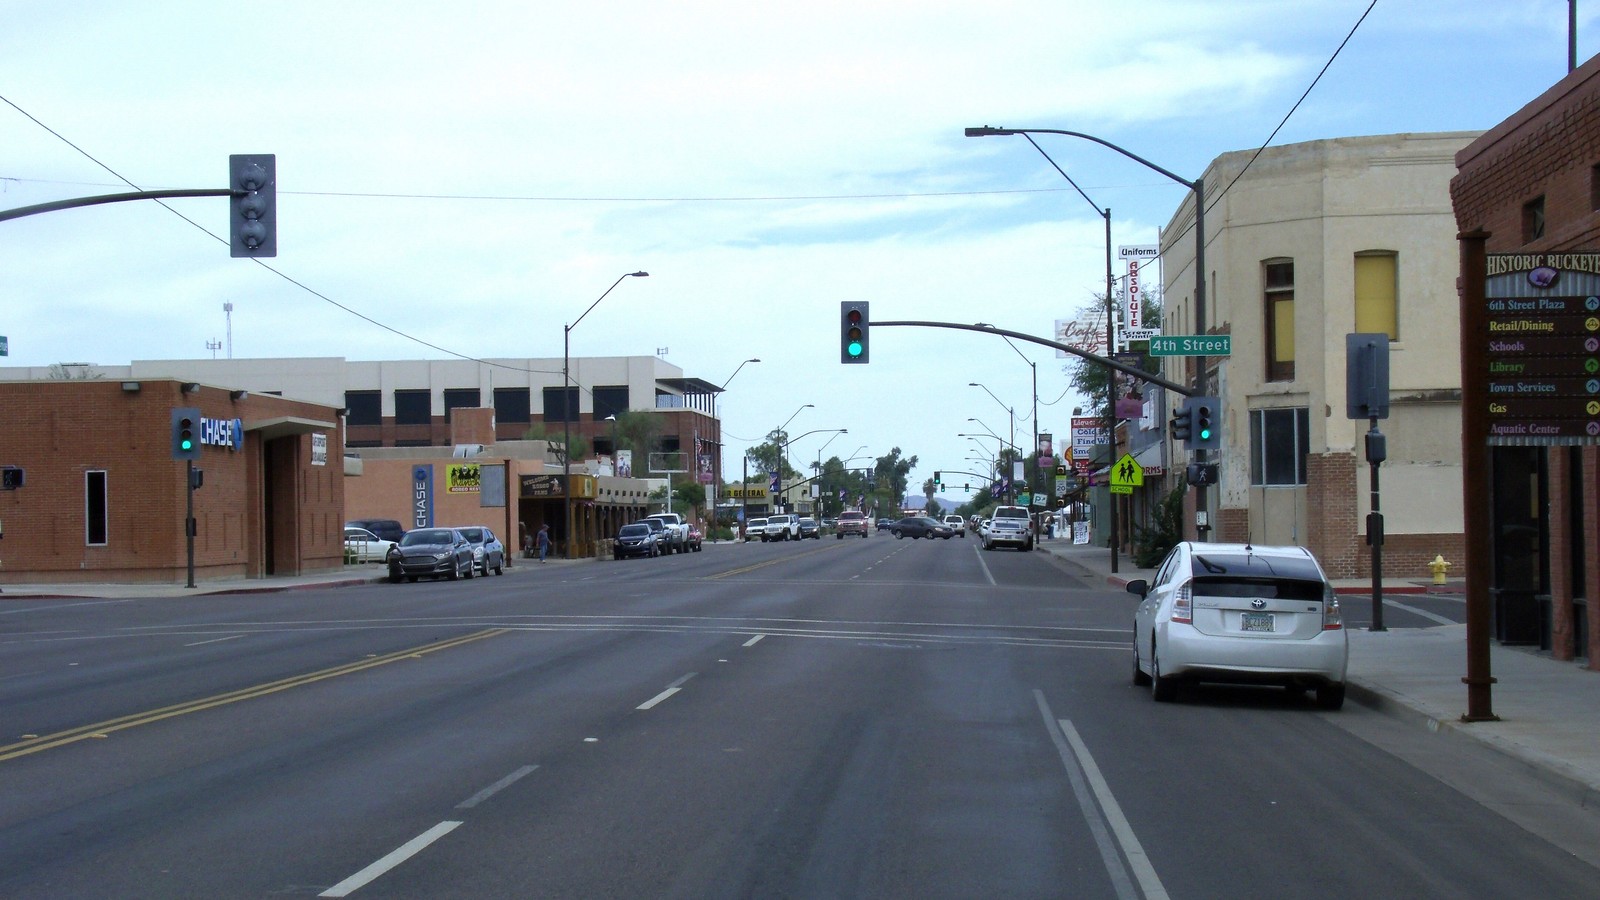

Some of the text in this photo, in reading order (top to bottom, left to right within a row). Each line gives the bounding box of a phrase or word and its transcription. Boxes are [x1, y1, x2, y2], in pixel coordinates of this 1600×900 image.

[1121, 248, 1157, 256] Uniforms
[1487, 254, 1600, 276] HISTORIC BUCKEYE
[1129, 261, 1139, 327] ABSOLUTE
[1489, 299, 1565, 311] 6th Street Plaza
[1490, 321, 1554, 331] Retail/Dining
[1152, 340, 1228, 351] 4th Street
[1489, 341, 1525, 351] Schools
[1490, 362, 1525, 373] Library
[1489, 382, 1556, 392] Town Services
[1489, 403, 1507, 413] Gas
[200, 417, 233, 447] CHASE
[1490, 424, 1560, 435] Aquatic Center
[734, 489, 765, 497] GEERAL
[416, 481, 426, 528] CHASE
